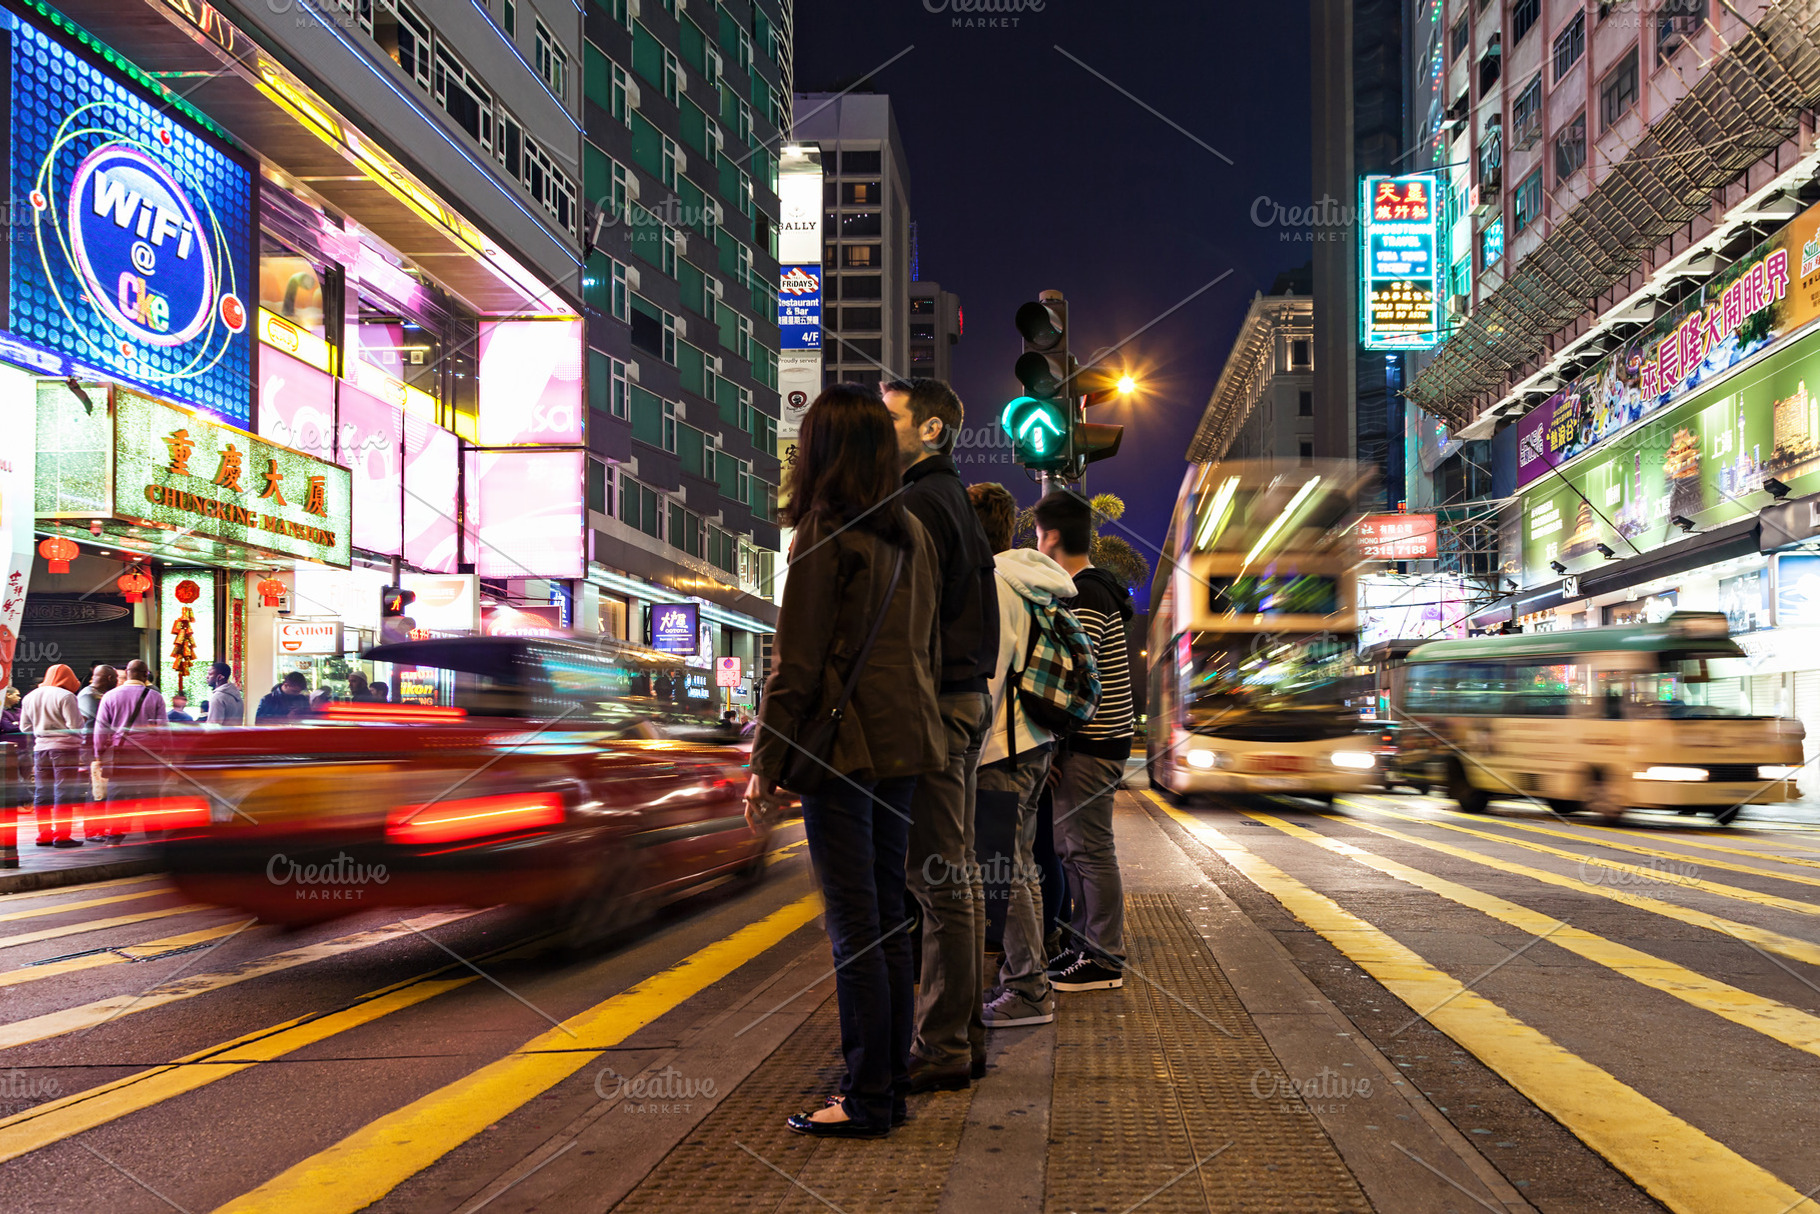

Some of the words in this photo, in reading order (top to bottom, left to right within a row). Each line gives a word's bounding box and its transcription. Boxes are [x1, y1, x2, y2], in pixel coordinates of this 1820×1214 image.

[93, 168, 194, 260] WiFi
[130, 240, 156, 276] @
[786, 307, 793, 315] &
[794, 307, 808, 315] Bar
[1639, 249, 1789, 401] 來長隆大開眼界
[802, 332, 819, 342] 4/F
[144, 484, 258, 529] CHUNGKING
[259, 513, 337, 548] MANSIONS
[1364, 545, 1394, 556] 2315
[1396, 545, 1427, 555] 7188
[1562, 576, 1579, 599] ISA
[282, 625, 334, 636] Canon
